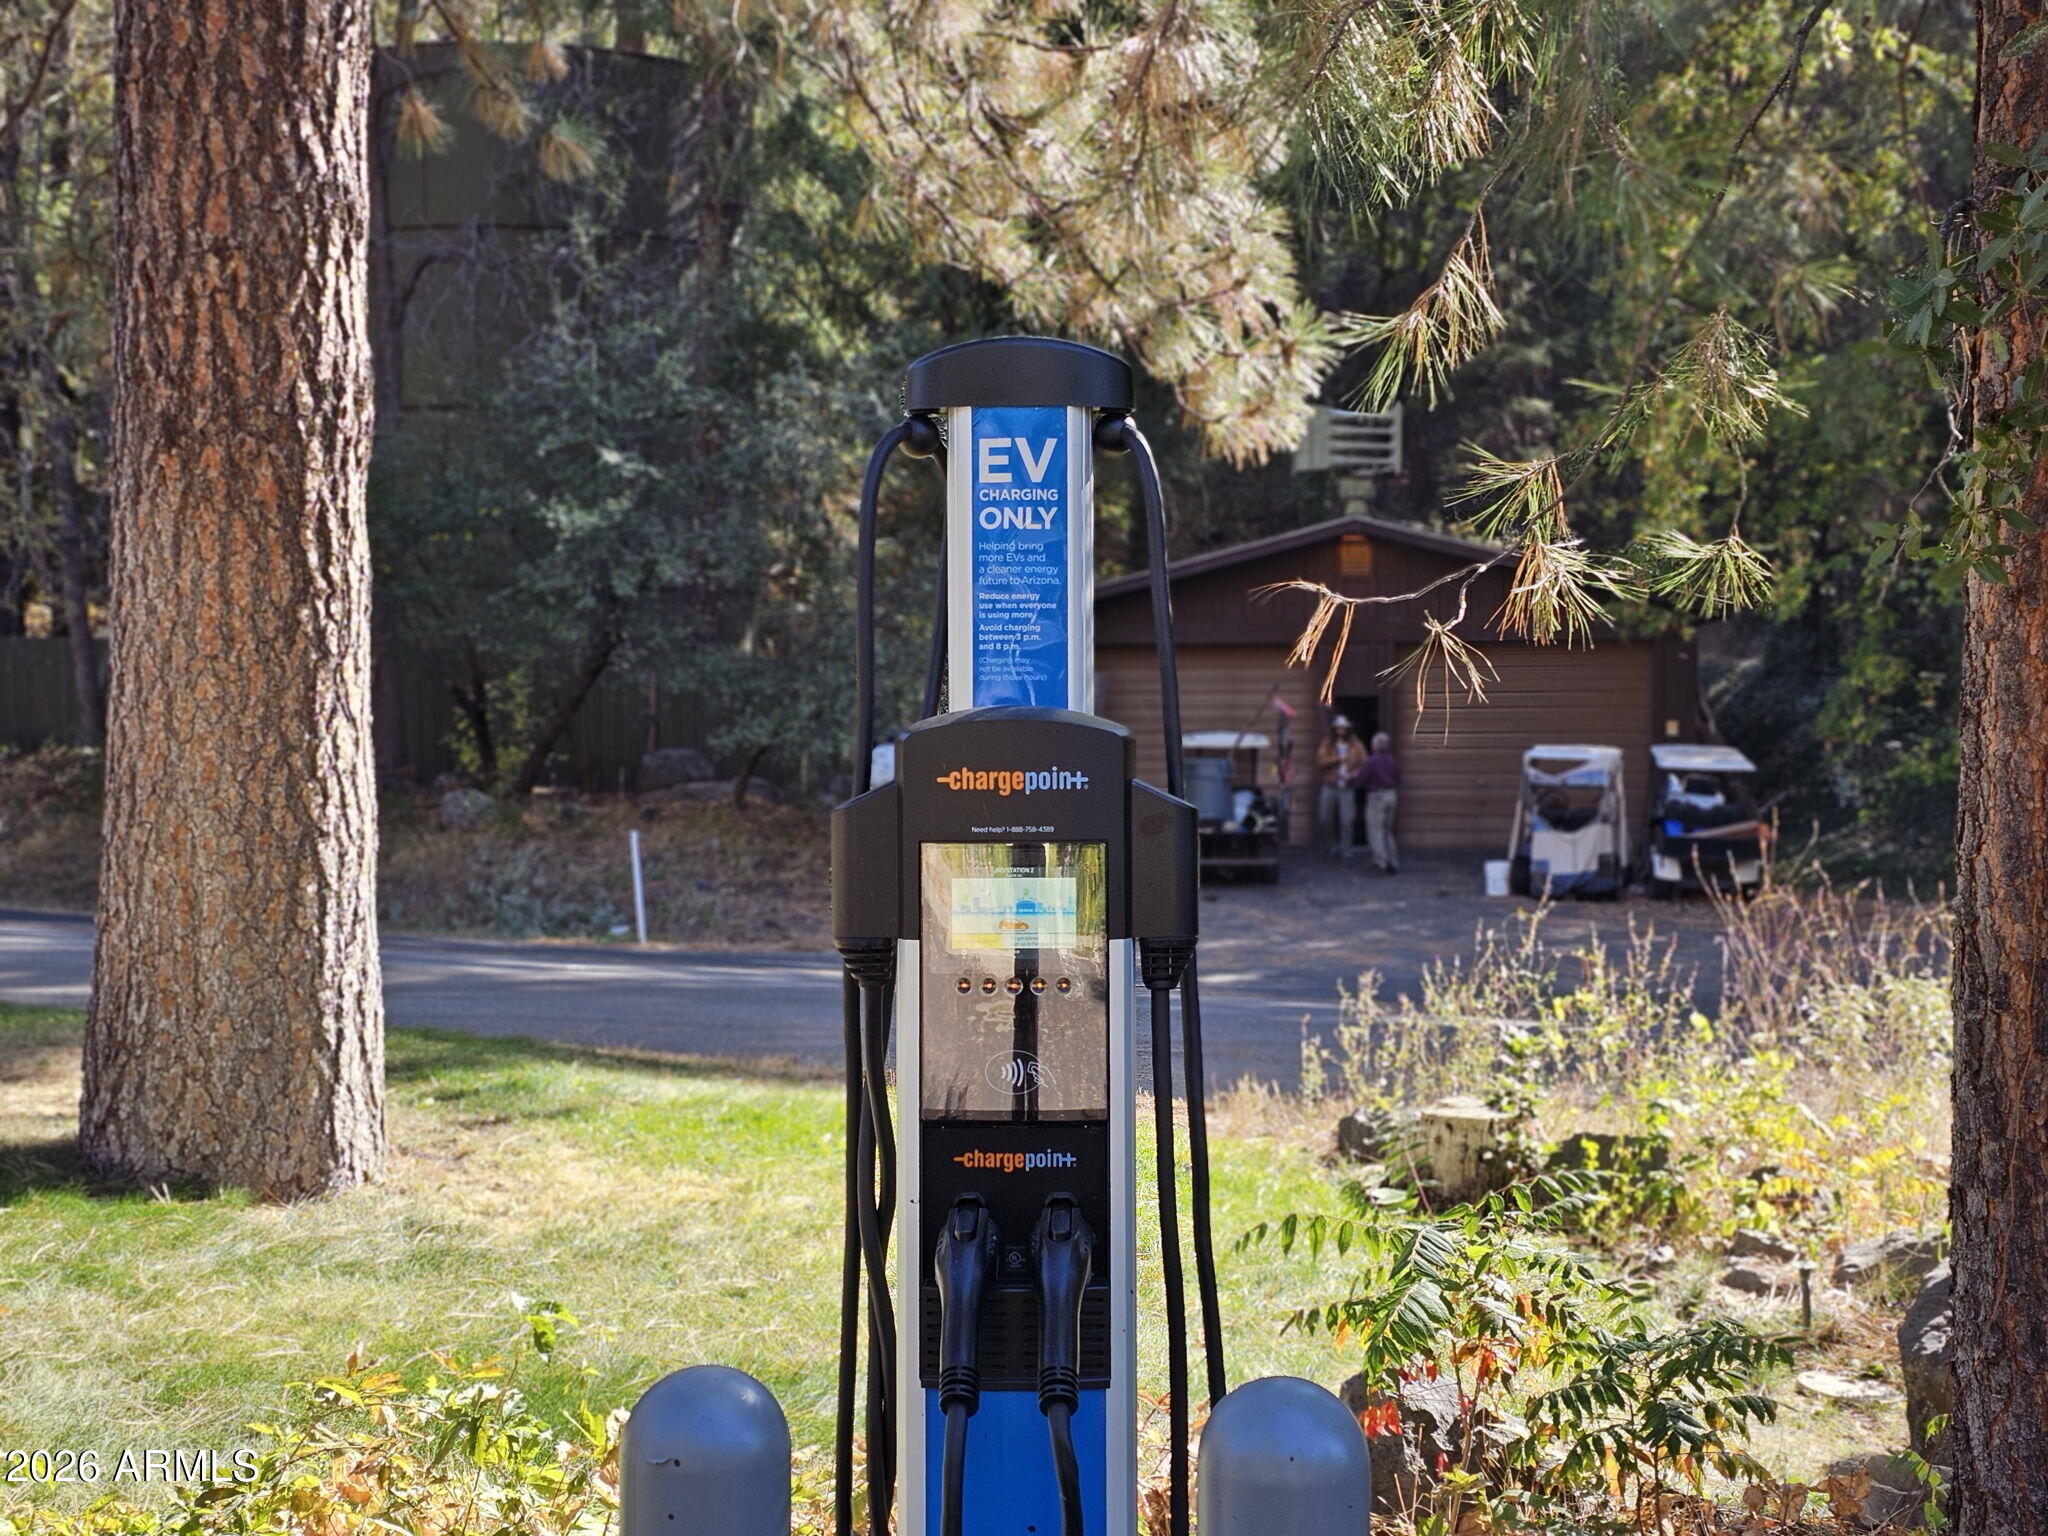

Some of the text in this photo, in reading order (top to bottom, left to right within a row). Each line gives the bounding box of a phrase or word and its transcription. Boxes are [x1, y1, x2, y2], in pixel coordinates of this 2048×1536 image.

[978, 437, 1058, 483] EV
[979, 488, 1059, 501] CHARGING
[979, 506, 1058, 530] ONLY
[978, 541, 1044, 552] Helping bring
[978, 553, 1046, 562] more EVs and
[978, 565, 1059, 575] a cleaner energy
[978, 576, 1062, 585] future to Arizona.
[978, 592, 1041, 602] Reduce energy
[978, 611, 986, 619] is
[987, 611, 1010, 619] using
[1004, 624, 1041, 632] charging
[978, 633, 1014, 641] between
[1023, 634, 1042, 642] p.m.
[978, 643, 1021, 652] and 8 p.m.
[978, 665, 991, 673] not
[978, 674, 1001, 682] during
[937, 766, 1089, 796] chargepoint
[989, 826, 1006, 834] help?
[953, 1149, 1077, 1172] chargepoint
